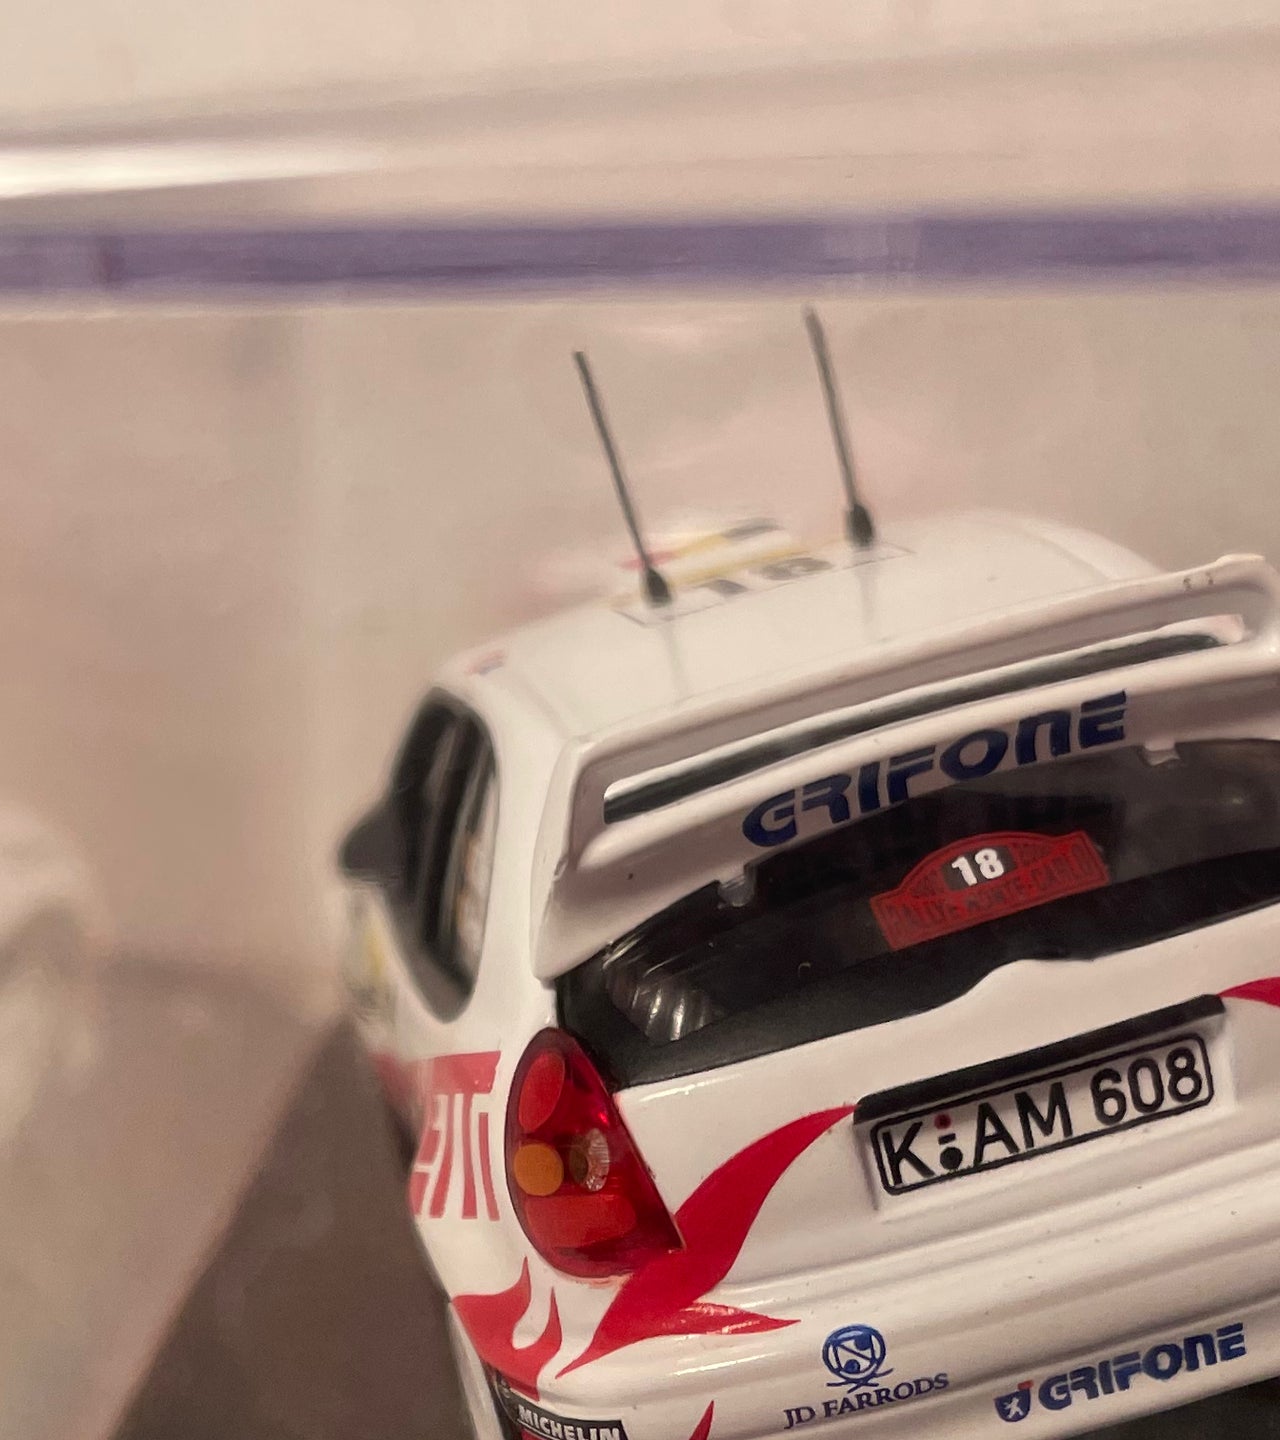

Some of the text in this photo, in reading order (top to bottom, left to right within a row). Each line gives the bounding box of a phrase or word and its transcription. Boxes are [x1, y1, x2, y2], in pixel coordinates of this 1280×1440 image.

[742, 691, 1128, 848] GRIFONE
[951, 848, 1006, 887] 18
[1090, 1046, 1203, 1126] 608
[783, 1373, 950, 1430] JD FARRODS
[1038, 1322, 1247, 1411] GRIFONE
